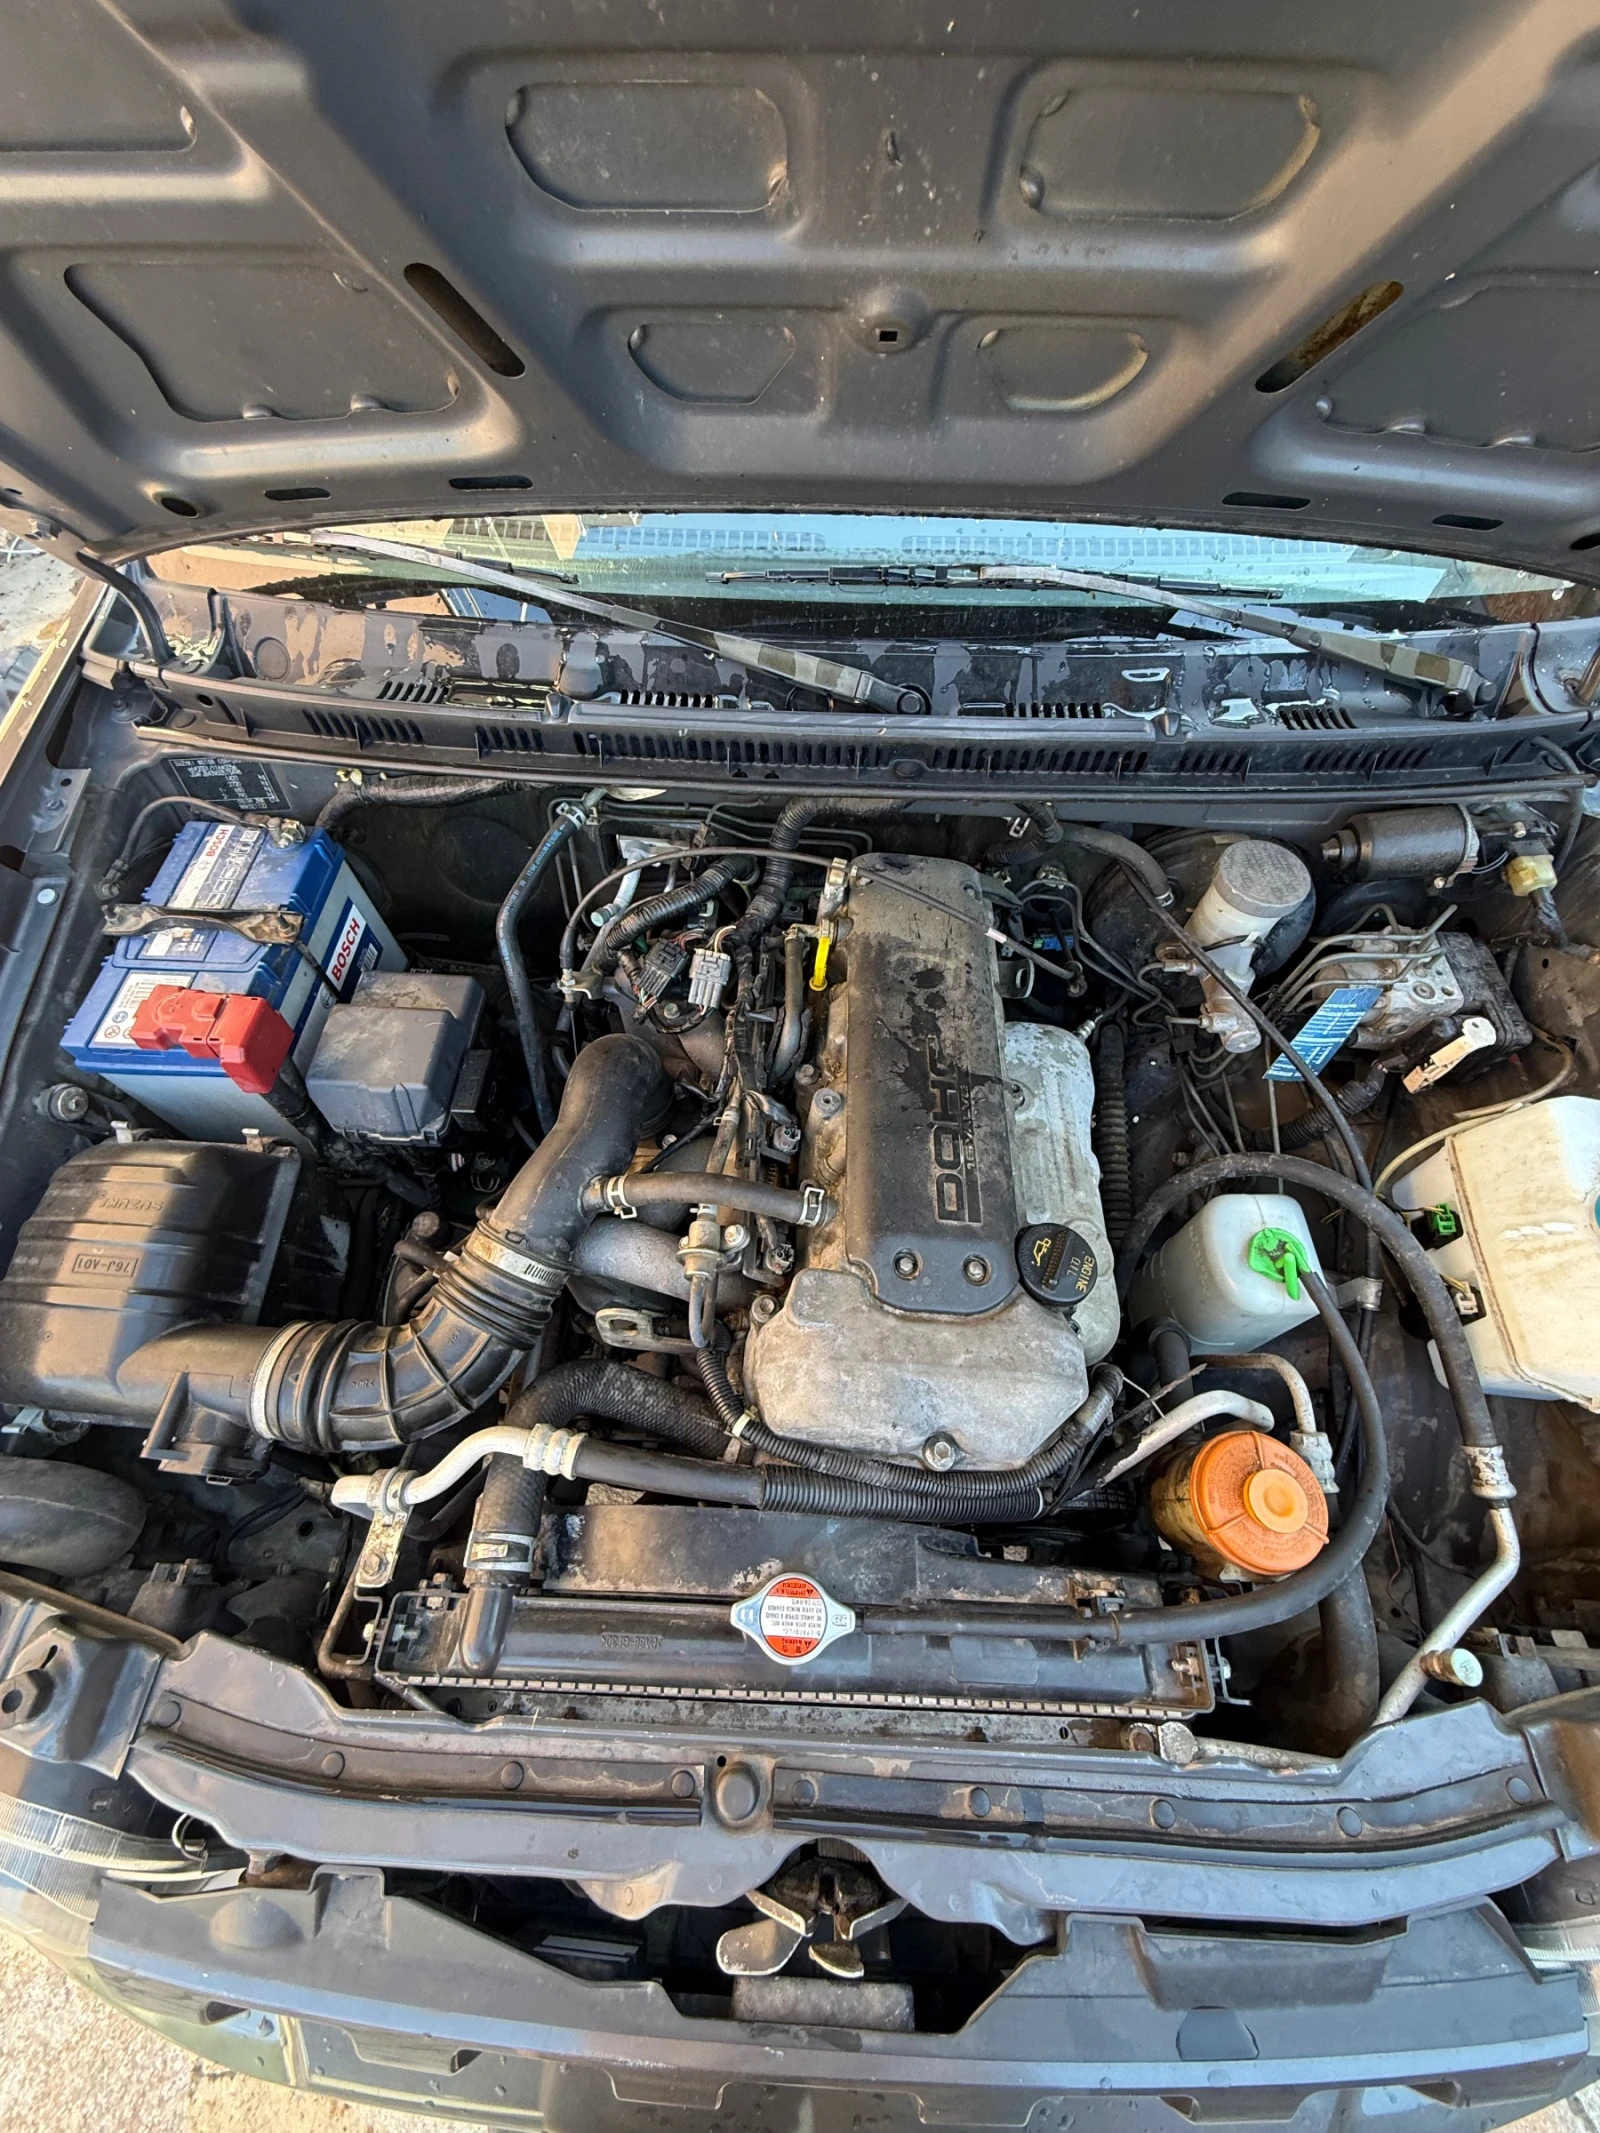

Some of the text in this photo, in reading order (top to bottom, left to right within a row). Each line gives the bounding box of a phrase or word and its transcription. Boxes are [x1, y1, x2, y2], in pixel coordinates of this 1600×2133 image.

[206, 829, 229, 857] BOSCH
[331, 918, 361, 982] BOSCH
[927, 1034, 968, 1223] DOHC
[100, 1197, 164, 1212] SUZUKI
[77, 1257, 131, 1273] 76J-A01
[1066, 1256, 1082, 1276] OIL
[1075, 1255, 1095, 1293] ENGINE
